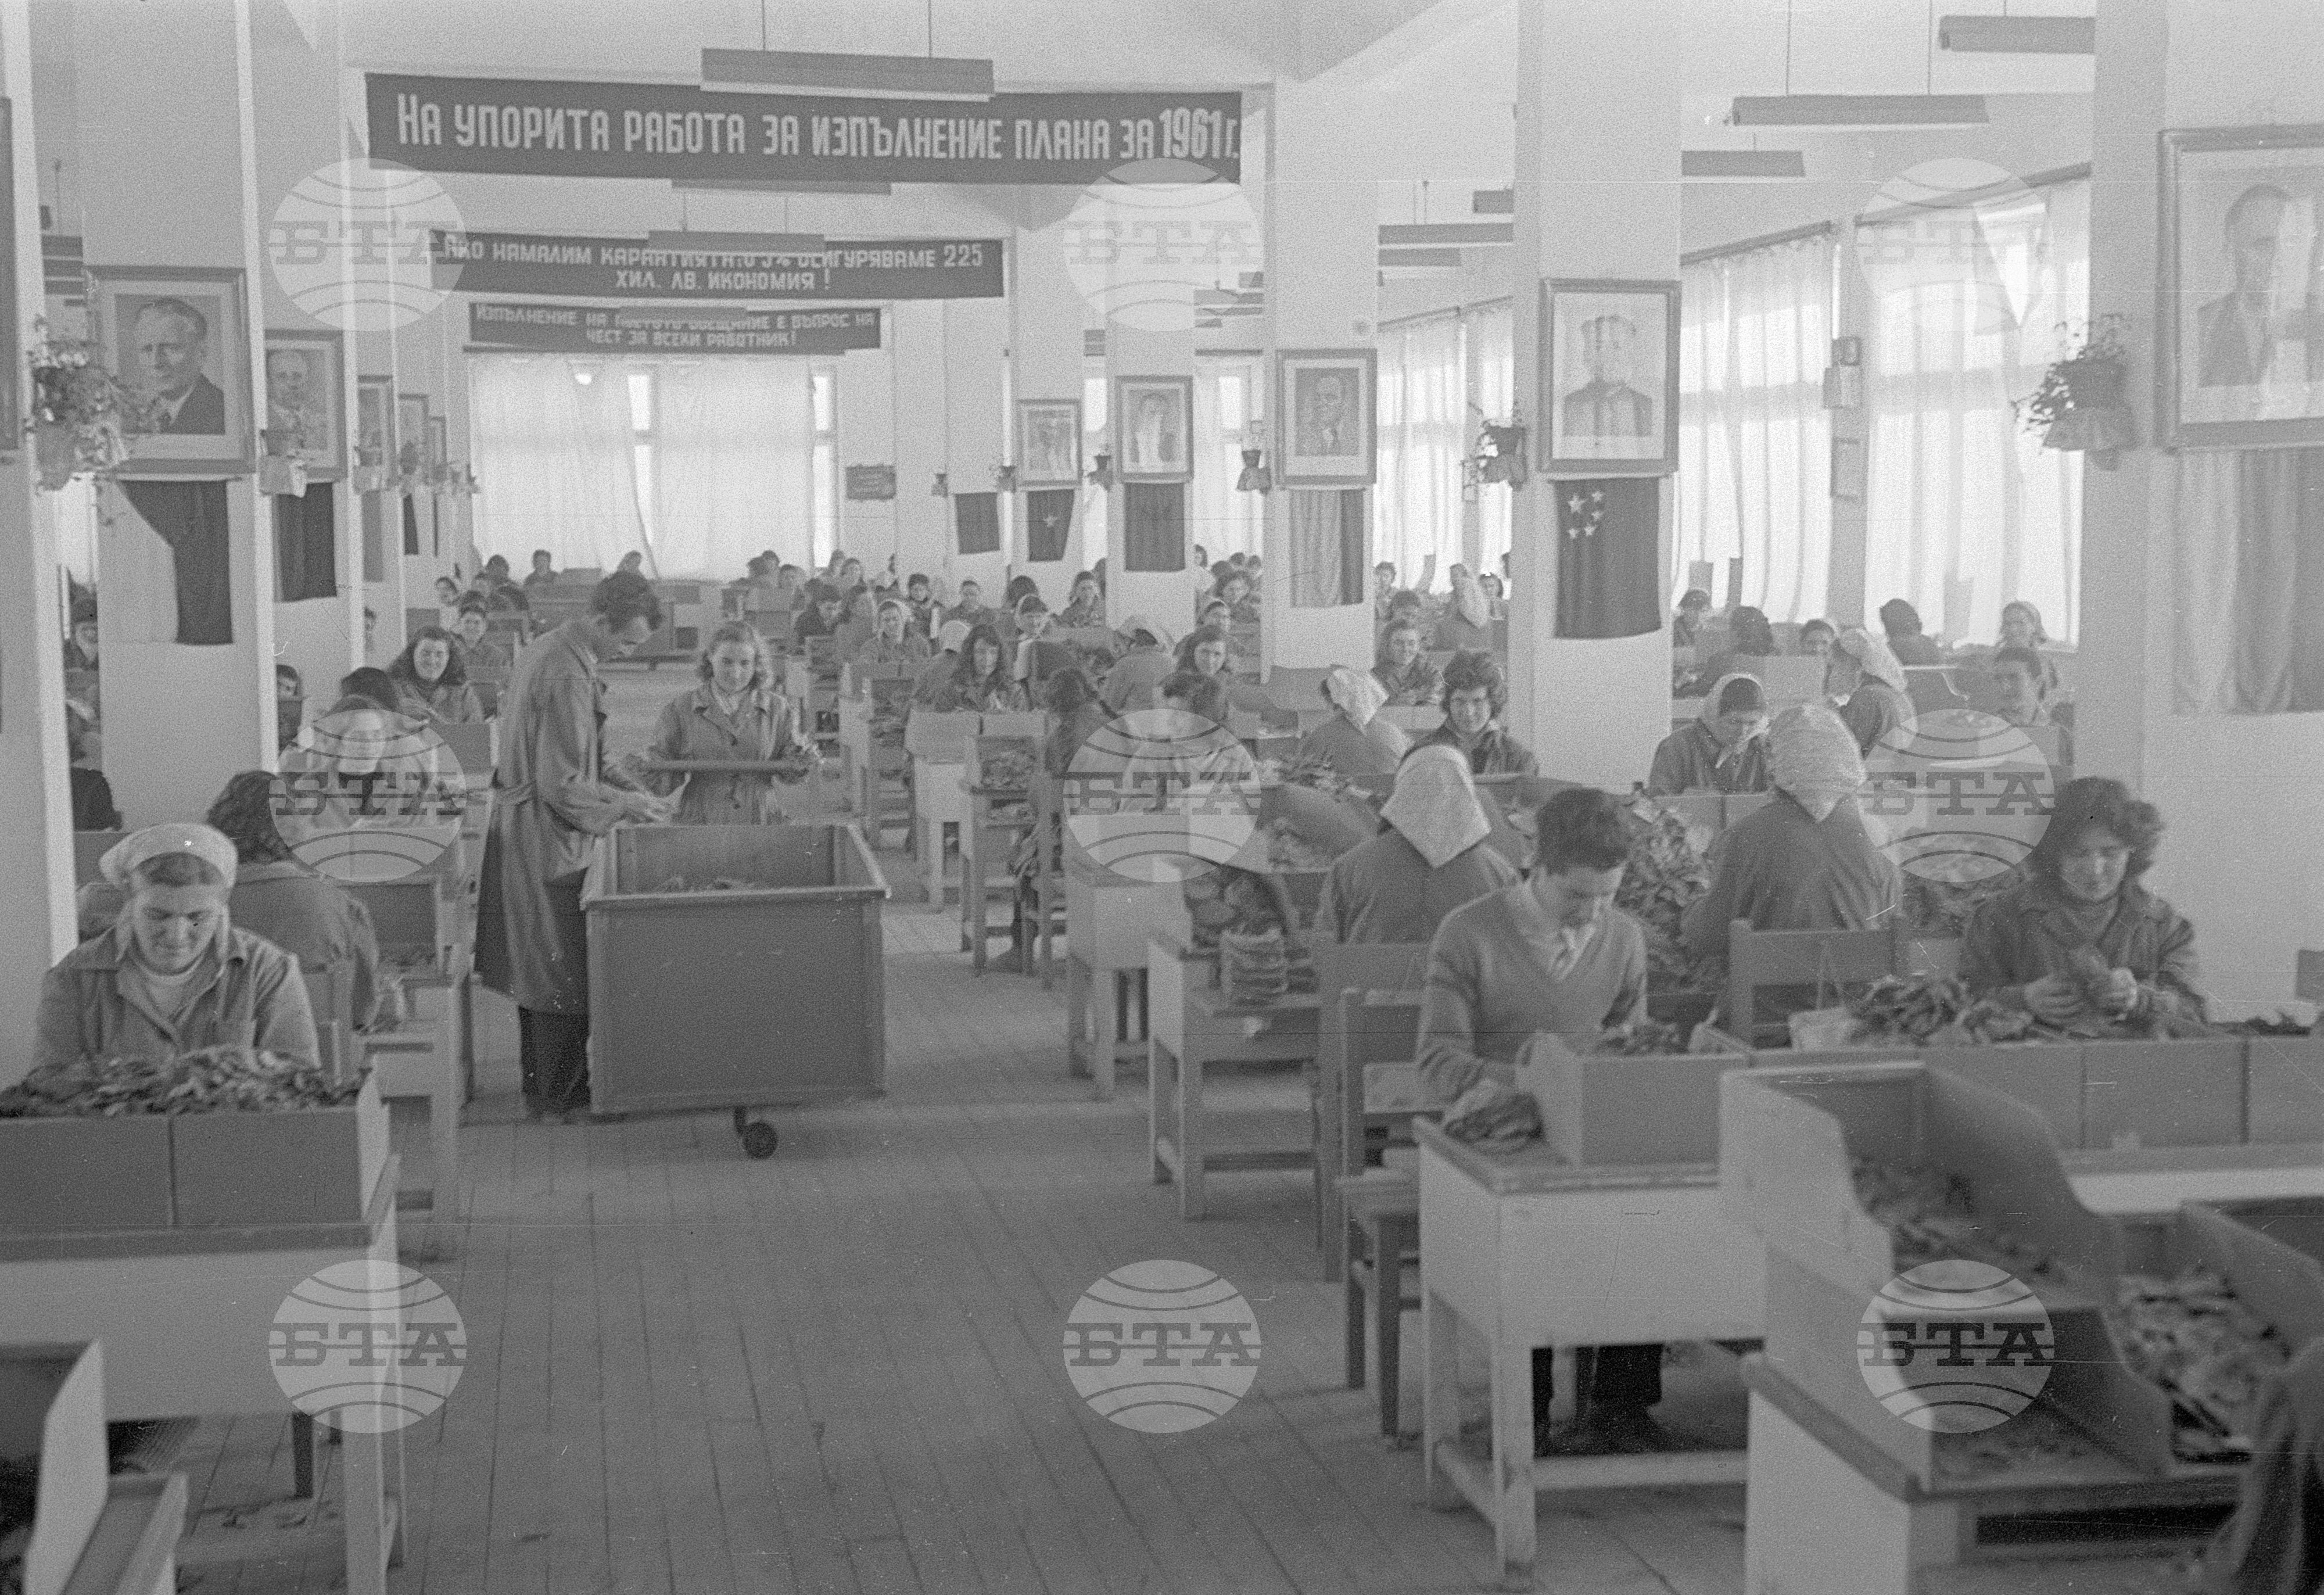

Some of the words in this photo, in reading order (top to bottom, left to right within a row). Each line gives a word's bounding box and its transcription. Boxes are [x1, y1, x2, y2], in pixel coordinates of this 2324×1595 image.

[454, 103, 610, 152] УПОРИТА
[624, 109, 746, 154] РАБОТА
[762, 114, 800, 156] ЗА
[812, 115, 1003, 160] ИЗПЪЛНЕНИЕ
[1014, 118, 1110, 160] ПЛАНА
[1119, 118, 1155, 160] ЗА
[493, 241, 592, 265] НАМАЛИМ
[943, 242, 982, 267] 225
[615, 269, 661, 289] ХИЛ.
[670, 270, 702, 291] ЛВ.
[475, 304, 577, 326] ИЗПЪЛНЕНИЕ
[584, 311, 607, 328] НА
[776, 314, 787, 330] Е
[790, 313, 850, 329] ВЪПРОС
[585, 328, 622, 345] ЧЕСТ
[628, 331, 648, 346] ЗА
[652, 331, 702, 347] ВСЕКИ
